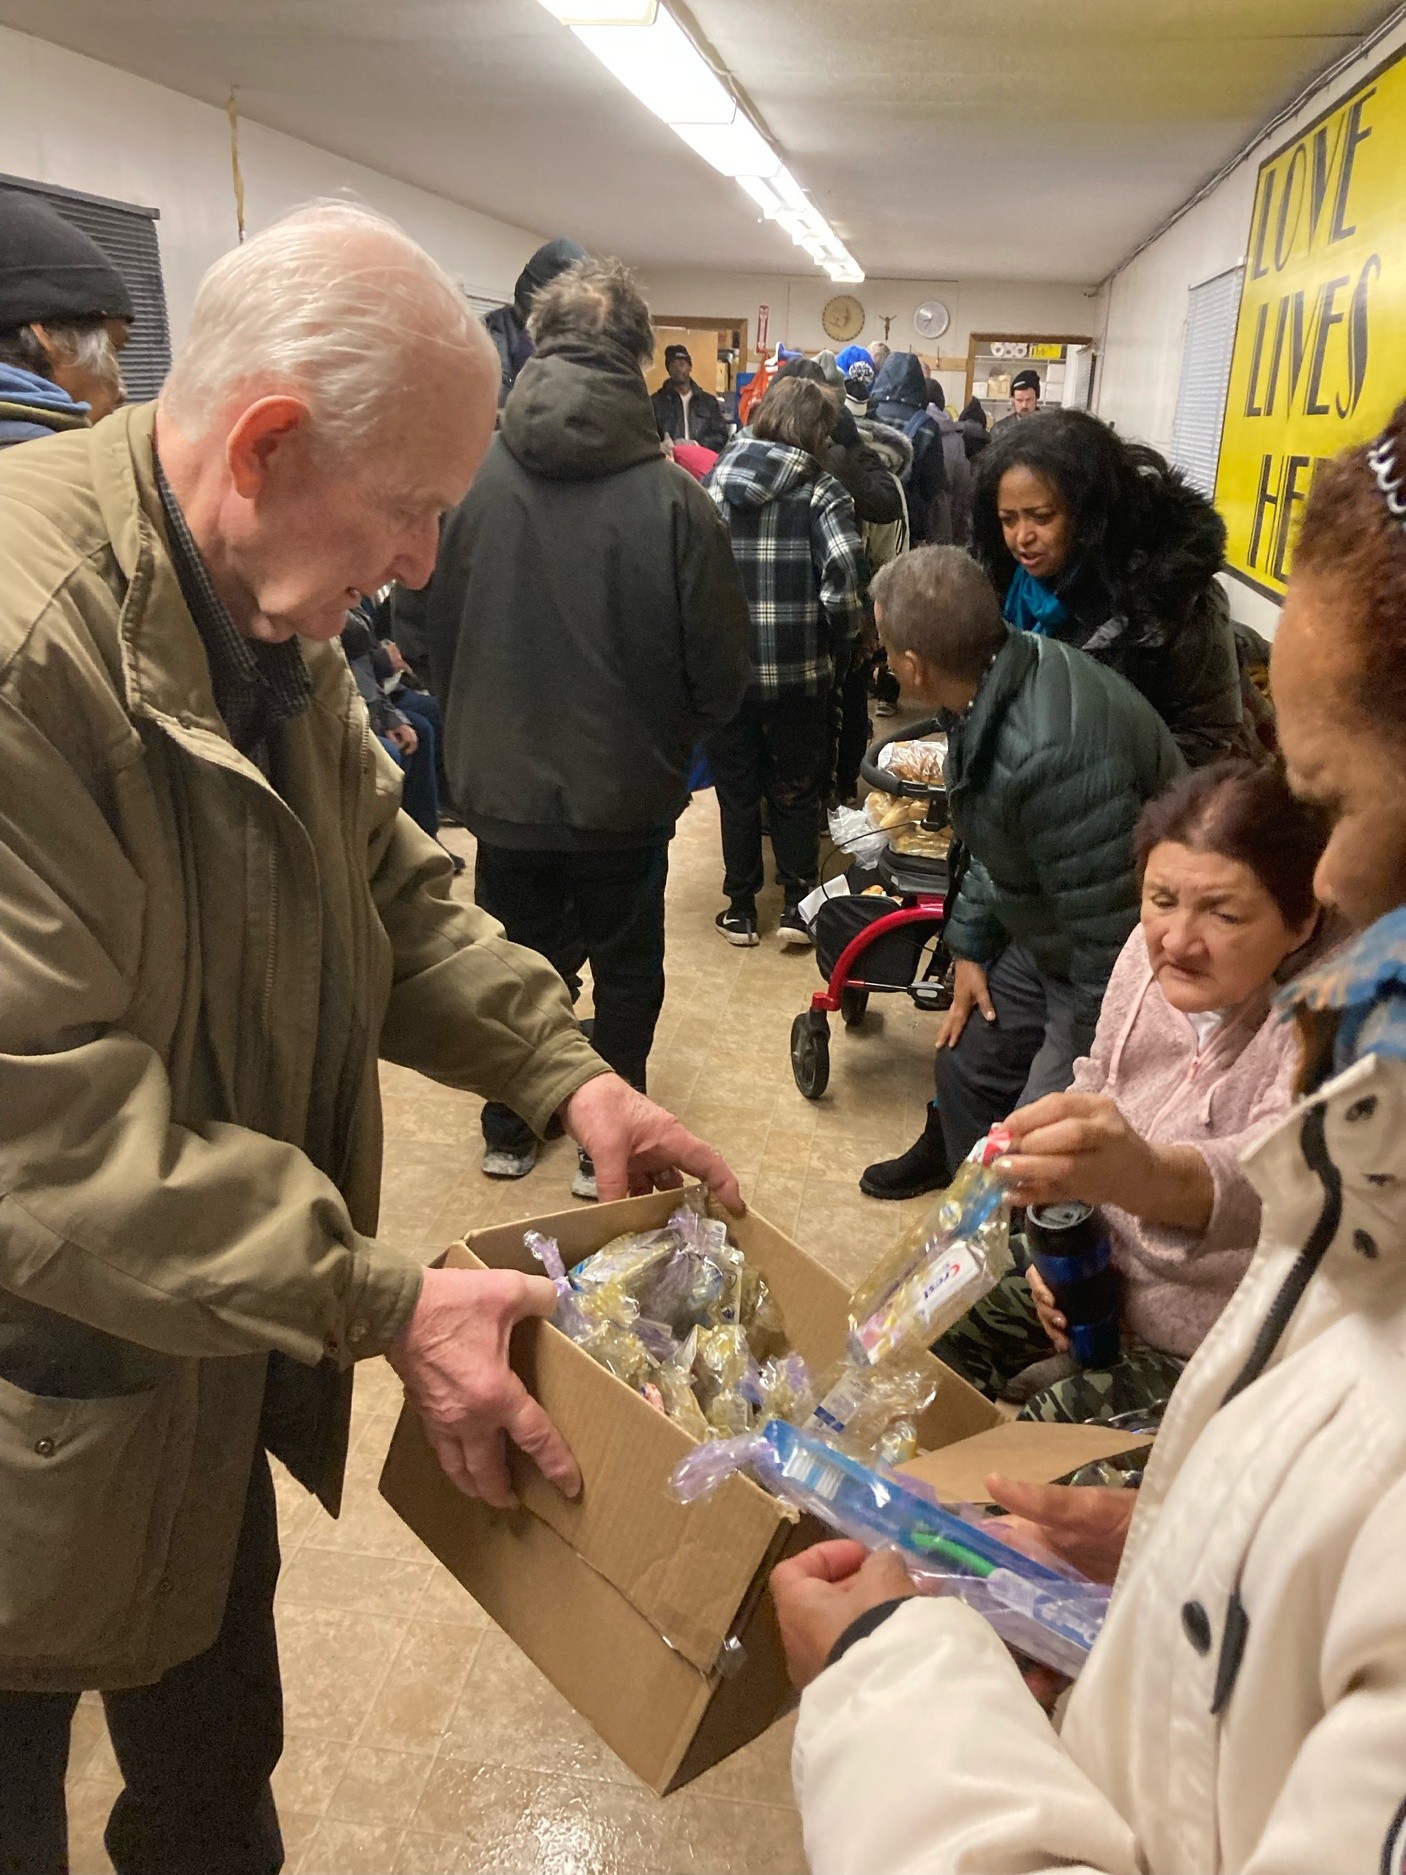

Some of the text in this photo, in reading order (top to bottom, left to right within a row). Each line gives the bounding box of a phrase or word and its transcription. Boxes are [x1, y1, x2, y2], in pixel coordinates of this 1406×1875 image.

[1253, 87, 1378, 279] LOVE
[1245, 254, 1381, 420] LIVES
[1247, 454, 1321, 582] HE
